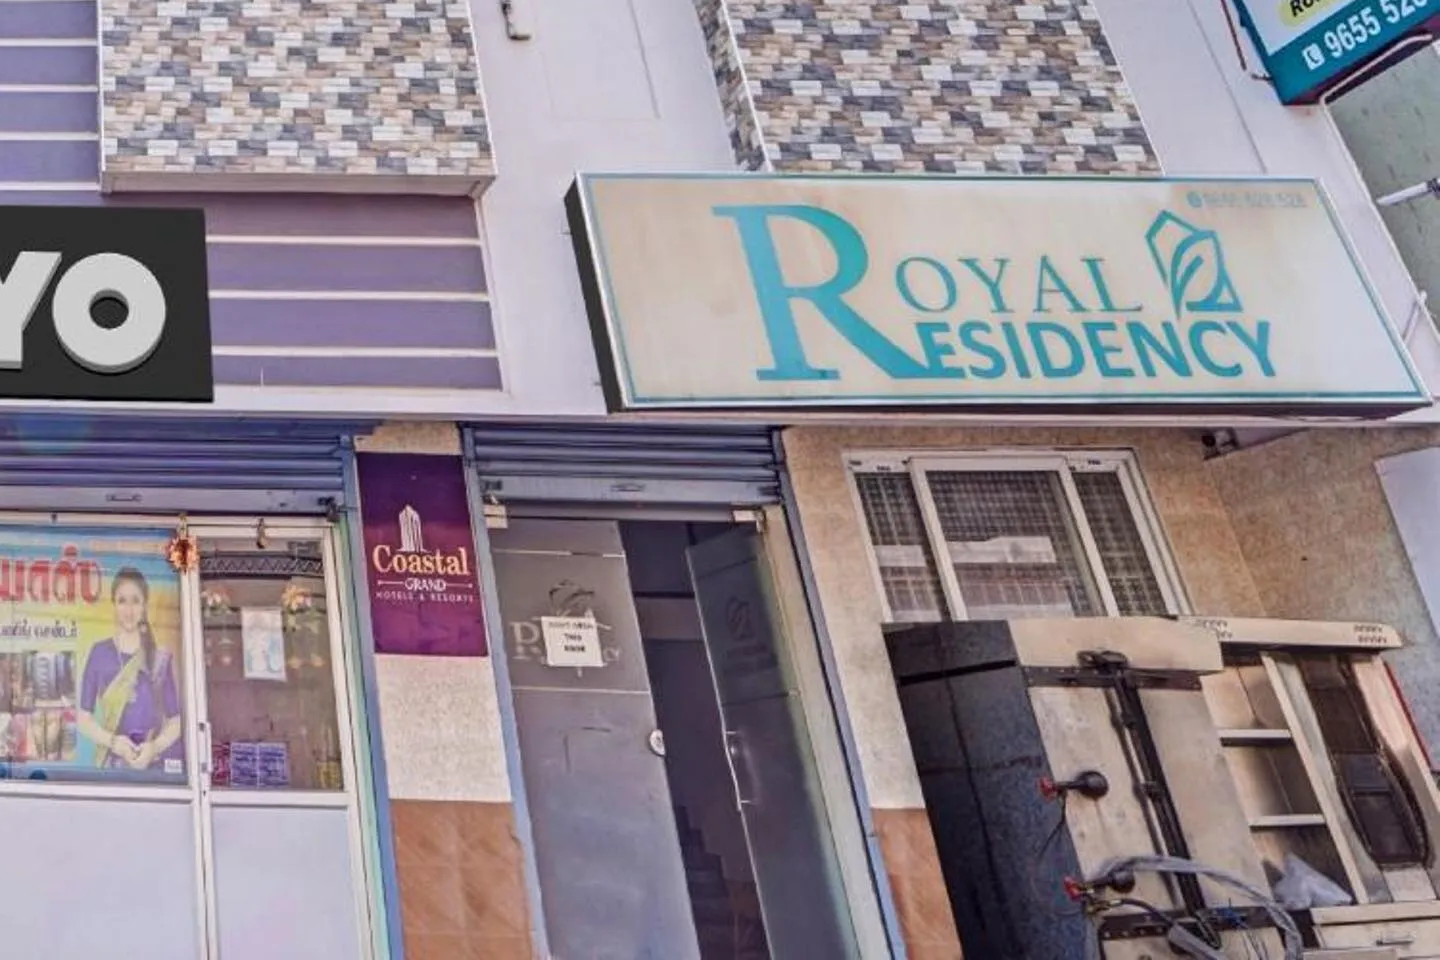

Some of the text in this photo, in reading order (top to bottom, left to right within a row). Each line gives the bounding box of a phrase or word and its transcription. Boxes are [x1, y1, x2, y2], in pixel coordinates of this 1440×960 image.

[1324, 7, 1381, 58] 9655
[372, 544, 471, 576] Coastal
[404, 577, 447, 592] GRAND
